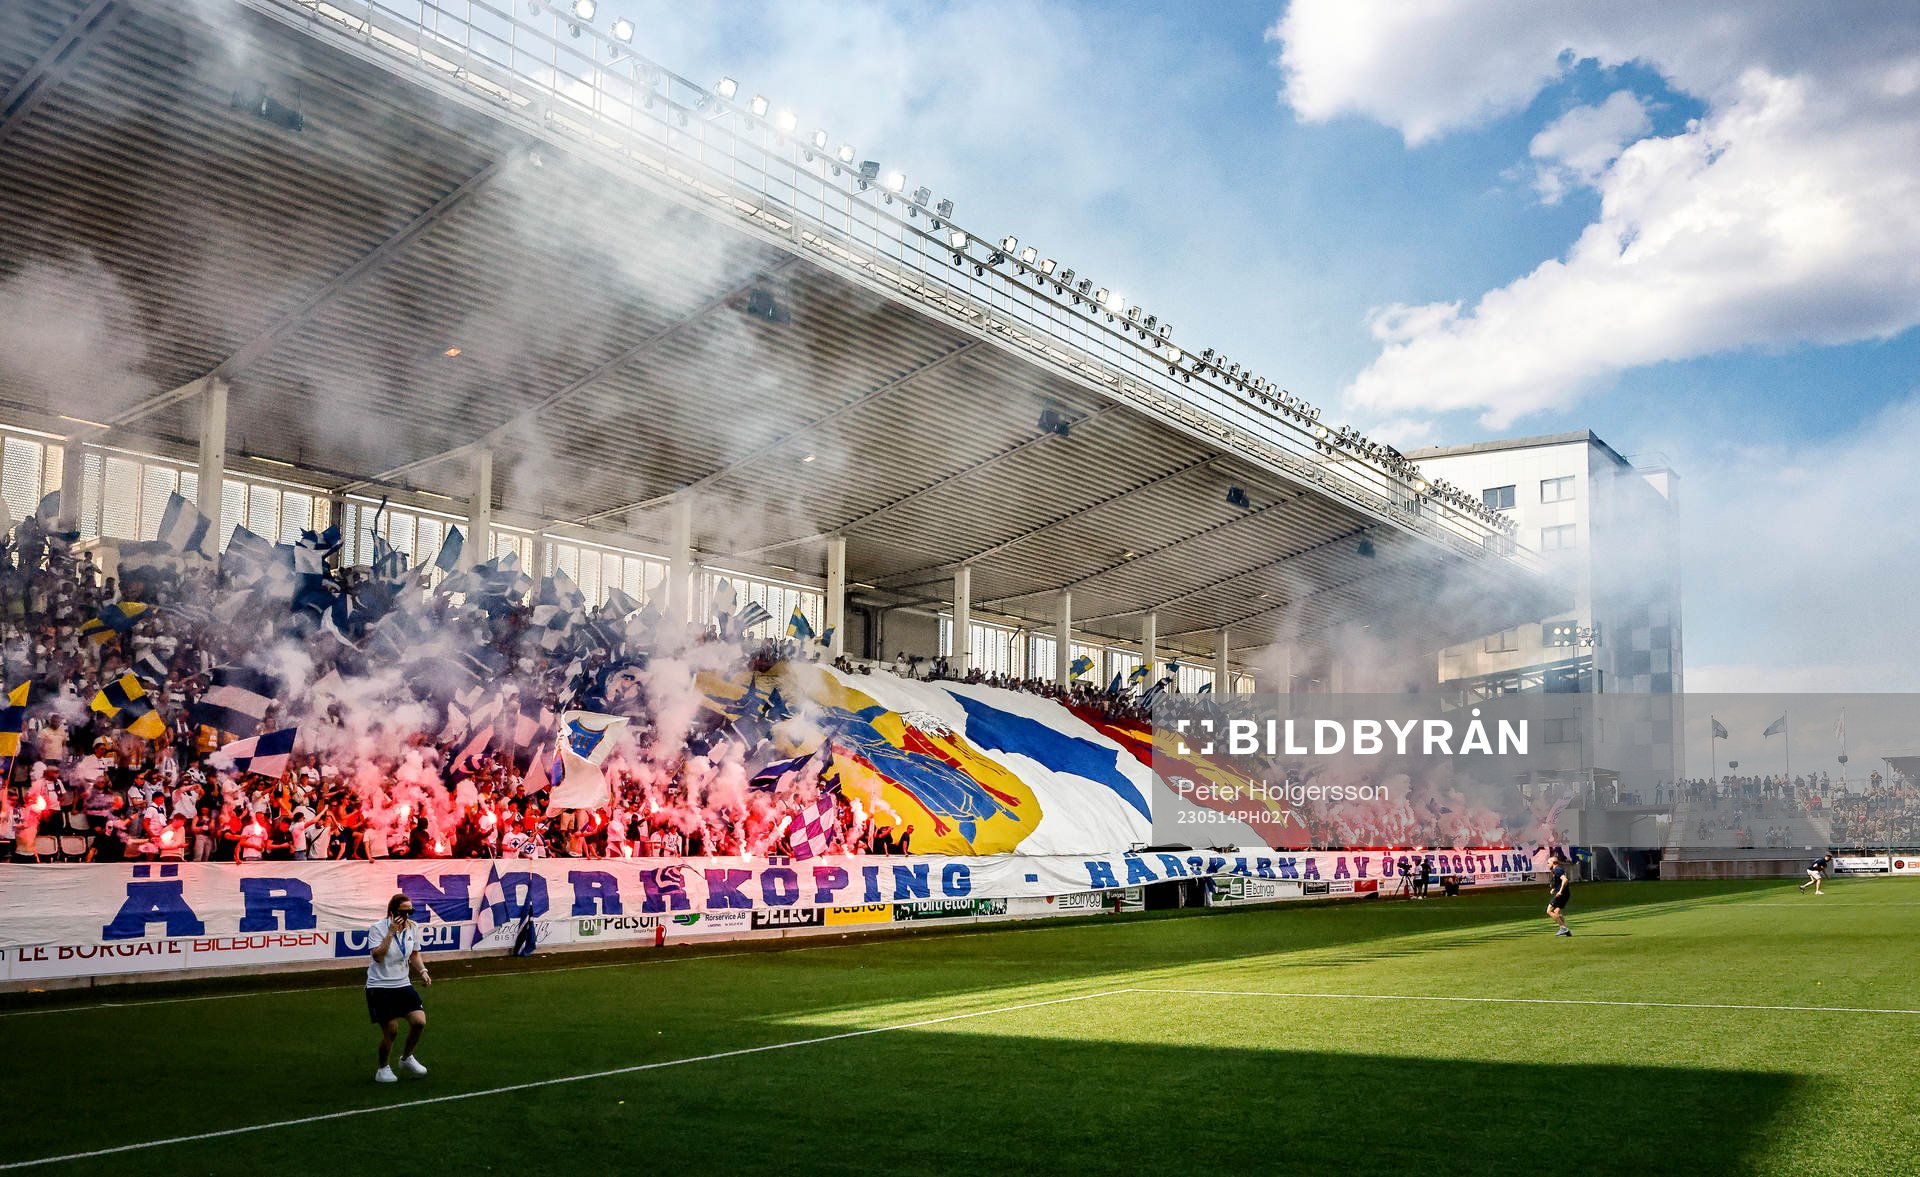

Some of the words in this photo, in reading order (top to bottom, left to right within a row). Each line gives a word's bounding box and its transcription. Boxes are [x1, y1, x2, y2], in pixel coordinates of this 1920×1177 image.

[102, 864, 318, 941] ÄR
[397, 857, 972, 923] NORRKÖPING
[1334, 857, 1370, 880] AV
[737, 912, 746, 920] AB
